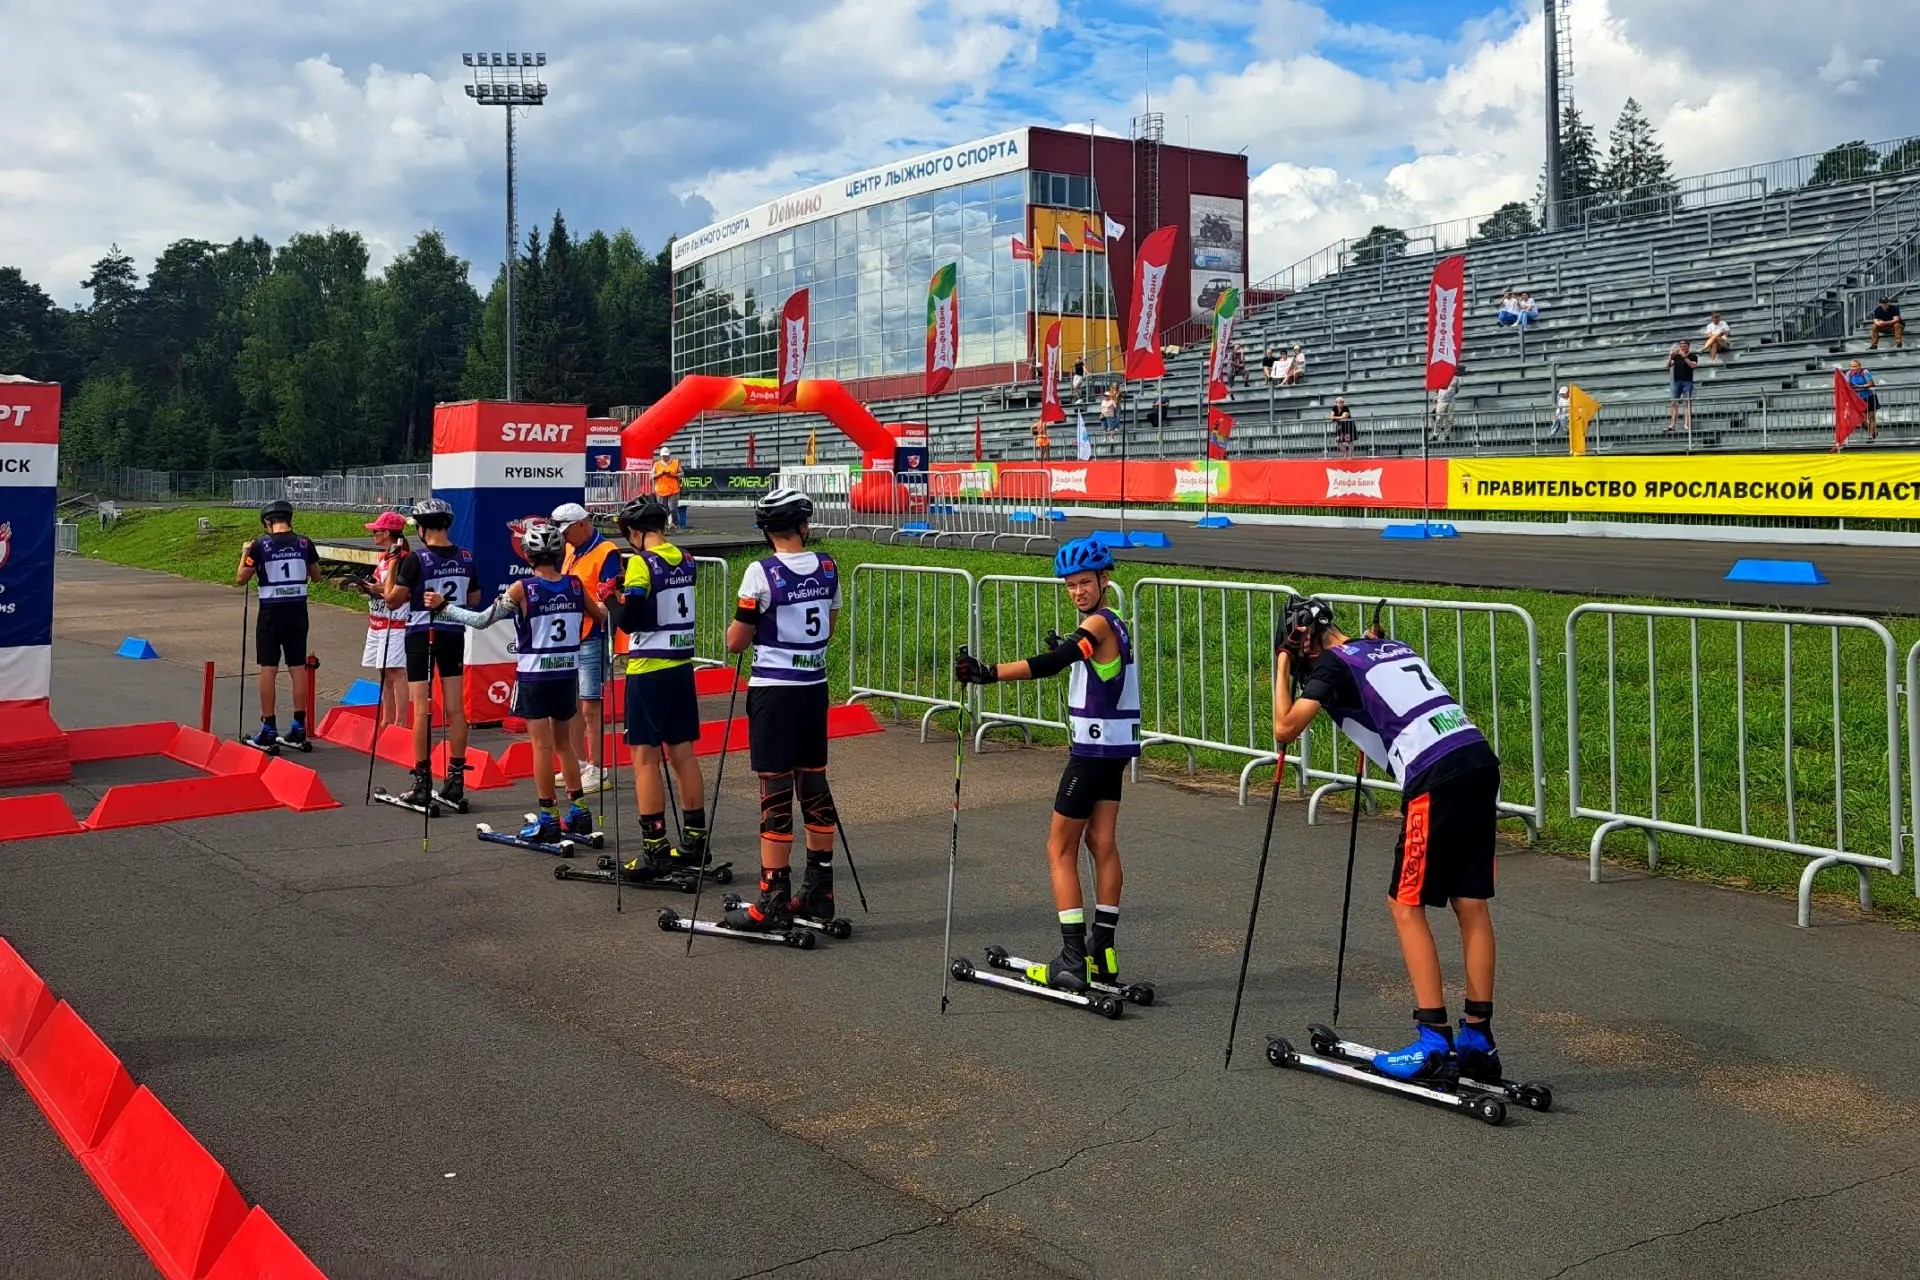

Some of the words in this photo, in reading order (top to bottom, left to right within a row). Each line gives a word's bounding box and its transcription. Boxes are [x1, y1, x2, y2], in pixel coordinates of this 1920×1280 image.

[845, 175, 882, 198] ЦЕНТР
[885, 155, 954, 187] ЛЫЖНОГО
[957, 139, 1018, 169] СПОРТА
[674, 241, 691, 259] ЦЕНТР
[722, 217, 750, 238] СПОРТА
[1147, 272, 1158, 302] Банк
[1439, 296, 1448, 320] Банк
[1143, 306, 1155, 343] Альфа
[938, 331, 949, 362] Альфа
[1438, 322, 1449, 356] Альфа
[790, 347, 800, 376] Альфа
[749, 390, 775, 402] Альфа
[501, 422, 574, 443] START
[0, 458, 31, 473] СК
[505, 466, 564, 478] RYBINSK
[1333, 478, 1357, 489] Альфа
[1357, 478, 1376, 486] Банк
[1477, 480, 1637, 498] ПРАВИТЕЛЬСТВО
[1644, 476, 1814, 500] ЯРОСЛАВСКОЙ
[1823, 481, 1920, 501] ОБЛАСТ
[280, 562, 290, 579] 1
[433, 567, 466, 577] РЫБИНСК
[664, 575, 693, 586] РБИНСК
[443, 581, 458, 602] 2
[787, 586, 830, 601] РЫБИНСК
[539, 602, 577, 613] РЫБИНСК
[550, 618, 567, 643] 3
[805, 606, 821, 637] 5
[1400, 663, 1435, 691] 7
[1088, 723, 1101, 739] 6
[1403, 812, 1426, 886] Kappa
